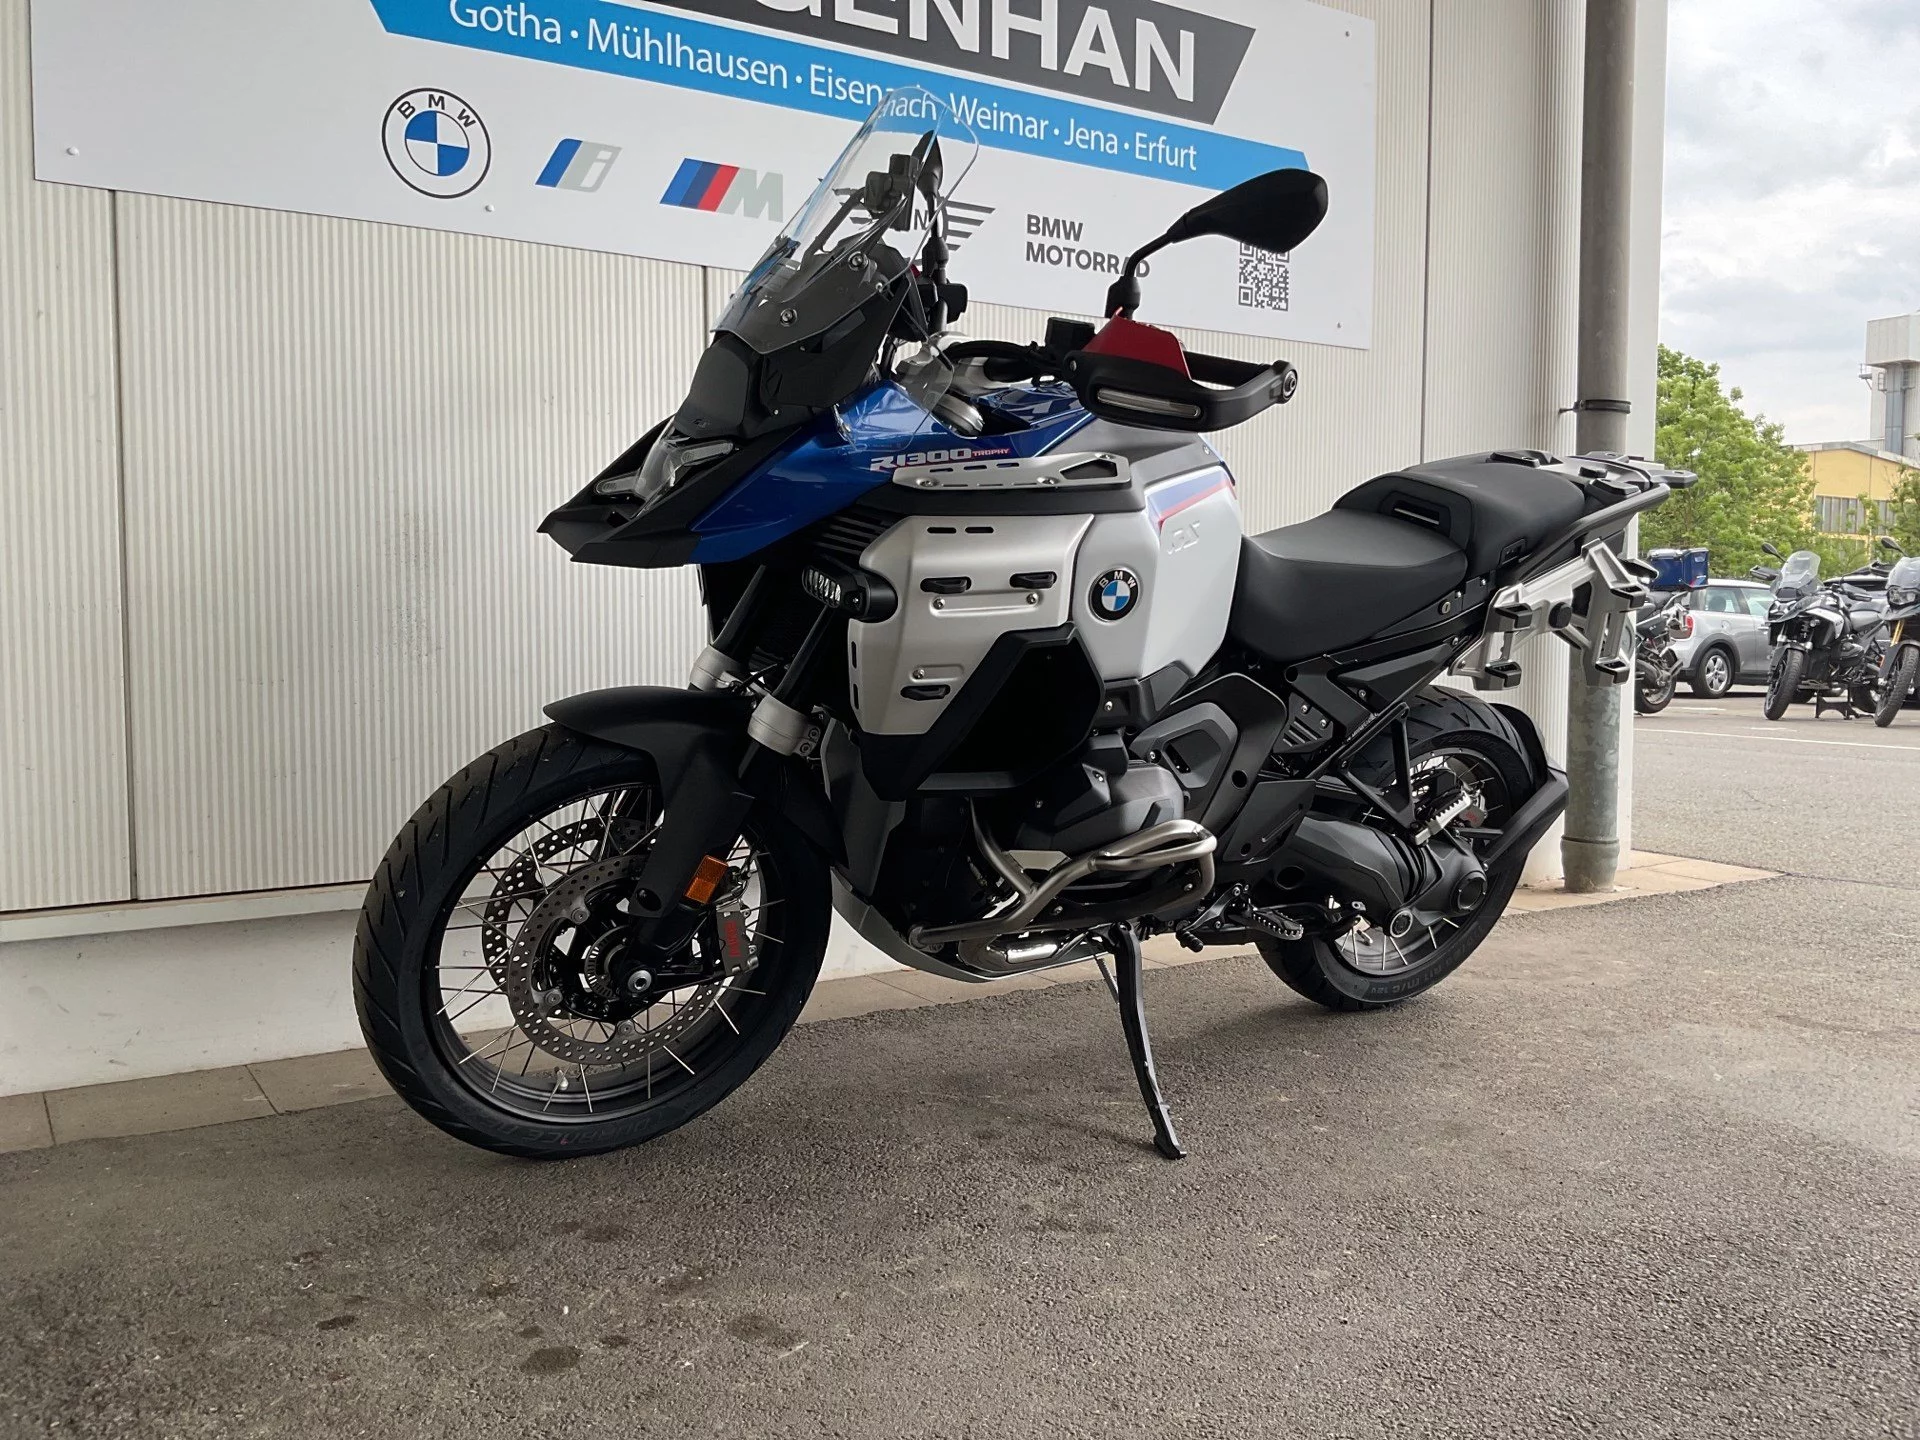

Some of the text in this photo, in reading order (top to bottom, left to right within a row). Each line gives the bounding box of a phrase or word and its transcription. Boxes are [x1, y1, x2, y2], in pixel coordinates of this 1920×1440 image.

[450, 0, 562, 45] Gotha
[587, 18, 788, 89] Mühlhausen
[950, 92, 1049, 141] Weimar
[1064, 118, 1118, 155] Jena
[1135, 132, 1197, 171] Erfurt
[396, 94, 477, 128] BMW
[1026, 213, 1084, 242] BMW
[870, 448, 1010, 472] R1300 TROPHY
[1099, 570, 1136, 589] BMW
